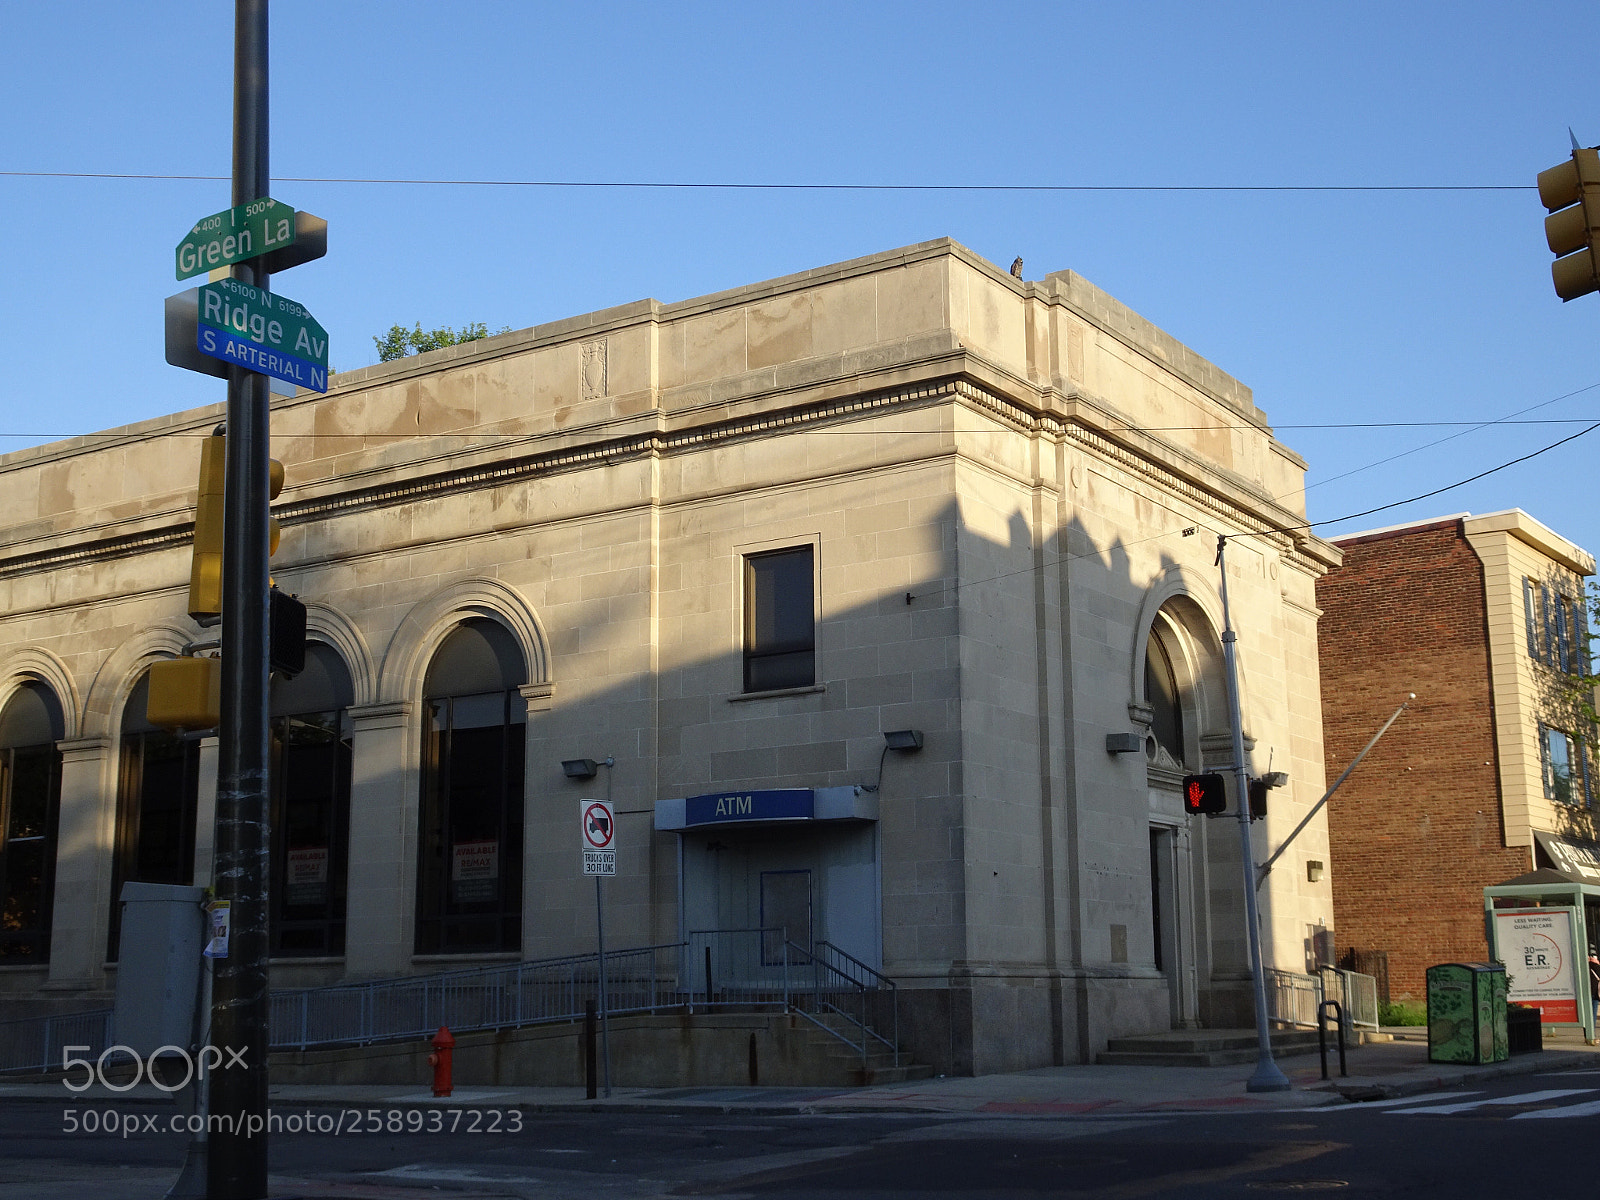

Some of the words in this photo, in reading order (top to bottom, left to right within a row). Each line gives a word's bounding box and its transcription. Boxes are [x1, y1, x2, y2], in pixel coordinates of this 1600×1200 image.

[202, 217, 221, 231] 400
[246, 201, 266, 217] 500
[179, 228, 251, 273] Green
[264, 218, 290, 246] La
[231, 282, 256, 300] 6100
[261, 291, 272, 308] N
[279, 300, 302, 317] 6199
[204, 289, 283, 344] Ridge
[295, 327, 325, 359] Av
[203, 330, 216, 352] S
[225, 340, 303, 381] ARTERIAL
[310, 367, 324, 390] N
[715, 796, 752, 817] ATM
[456, 846, 496, 856] AVAILABLE
[585, 854, 602, 863] TRUCKS
[603, 854, 614, 863] OVER
[587, 864, 596, 872] 30
[603, 864, 614, 873] LONG
[1524, 946, 1536, 954] 30
[1525, 954, 1550, 966] E.R.
